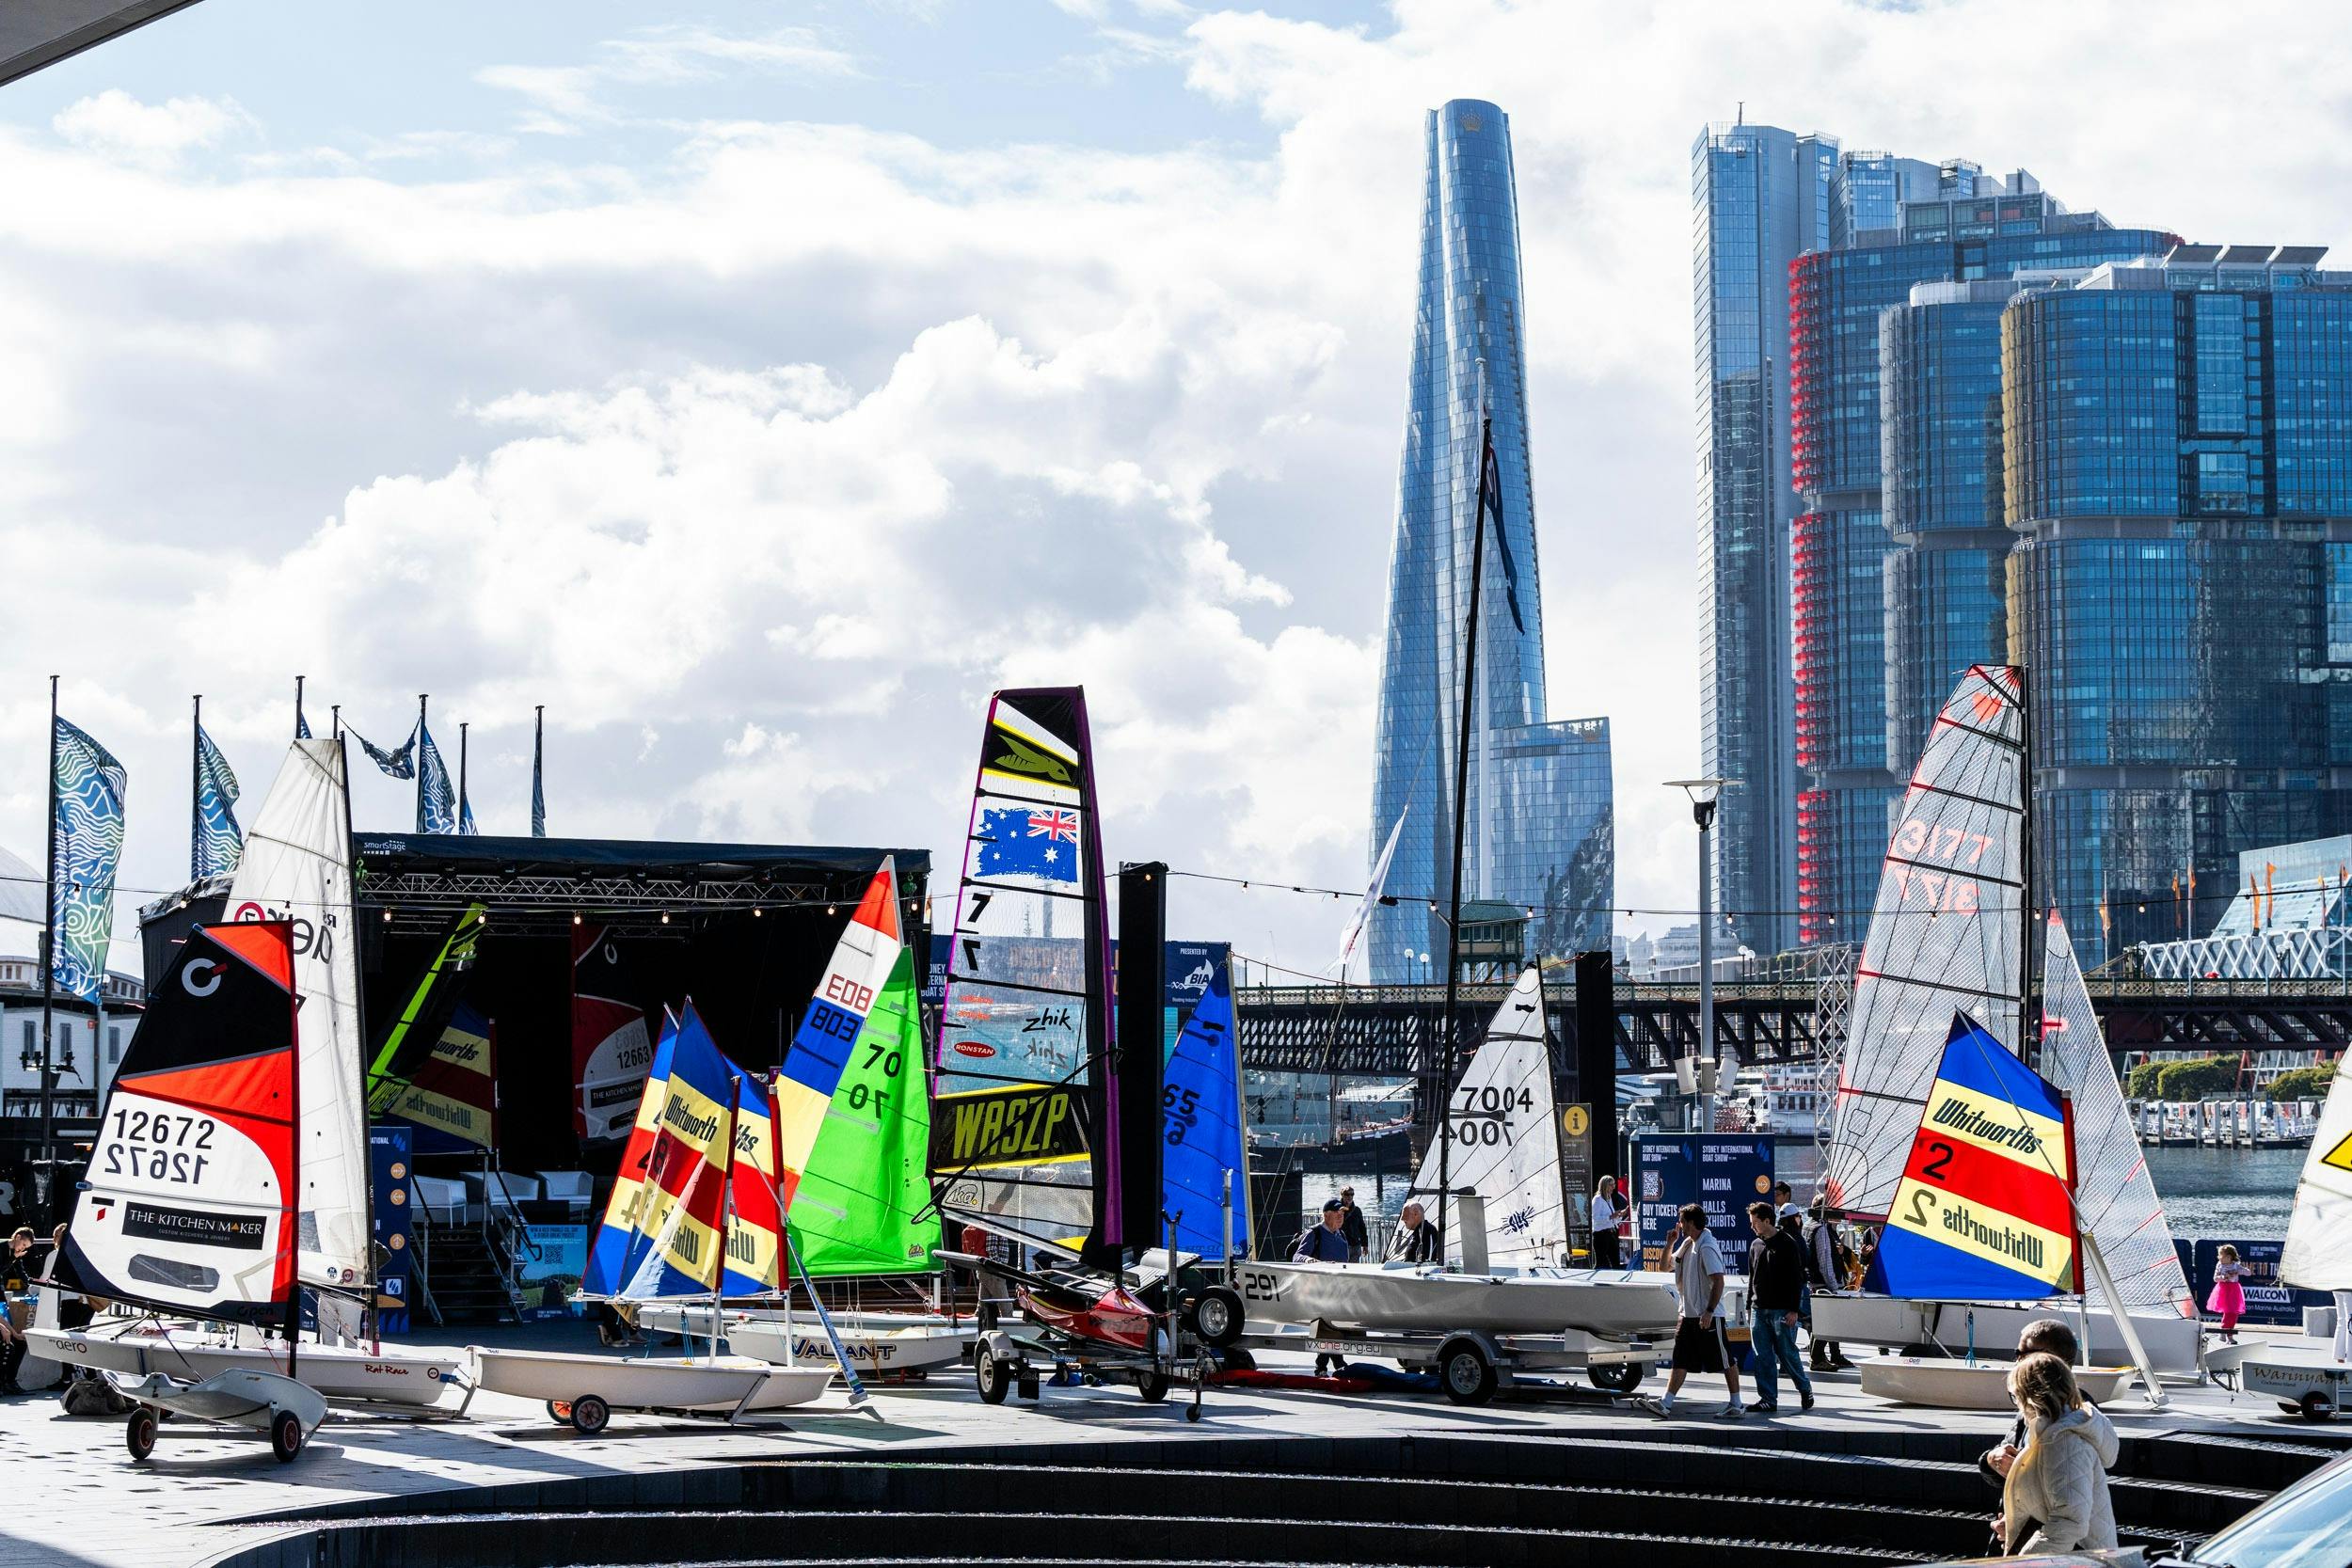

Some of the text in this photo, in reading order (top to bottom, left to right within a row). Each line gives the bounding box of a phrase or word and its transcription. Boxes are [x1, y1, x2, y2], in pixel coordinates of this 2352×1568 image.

[364, 842, 405, 851] smartStage
[1899, 819, 1994, 865] 3177
[967, 893, 992, 923] 7
[1190, 974, 1210, 985] BIA
[810, 1005, 859, 1042] 803
[1022, 1008, 1072, 1032] zhik
[436, 1041, 479, 1061] worths
[617, 1046, 650, 1069] 12663
[956, 1043, 994, 1055] RONSTAN
[862, 1043, 901, 1078] 70
[1163, 1084, 1200, 1115] 65
[1460, 1086, 1534, 1113] 7004
[113, 1109, 215, 1149] 12672
[665, 1094, 718, 1144] Whitworth
[953, 1093, 1069, 1160] WASZP
[1932, 1098, 2042, 1154] Whitworths
[371, 1136, 389, 1145] ATIONAL
[1922, 1142, 1953, 1180] 2
[1702, 1179, 1731, 1191] MARINA
[1643, 1204, 1677, 1216] BUY TICKETS
[1703, 1201, 1725, 1212] HALLS
[130, 1210, 155, 1223] THE
[158, 1213, 215, 1230] KITCHEN
[1643, 1218, 1657, 1230] HERE
[1643, 1247, 1663, 1259] DISCOV
[1718, 1240, 1747, 1252] TRALIAN
[1245, 1273, 1279, 1302] 291
[2245, 1290, 2287, 1301] WALCON
[2273, 1305, 2296, 1313] Australia
[56, 1339, 87, 1354] aero
[790, 1338, 897, 1360] VALANT
[1307, 1340, 1380, 1354] vxone.org.au
[364, 1364, 408, 1375] Rat Race
